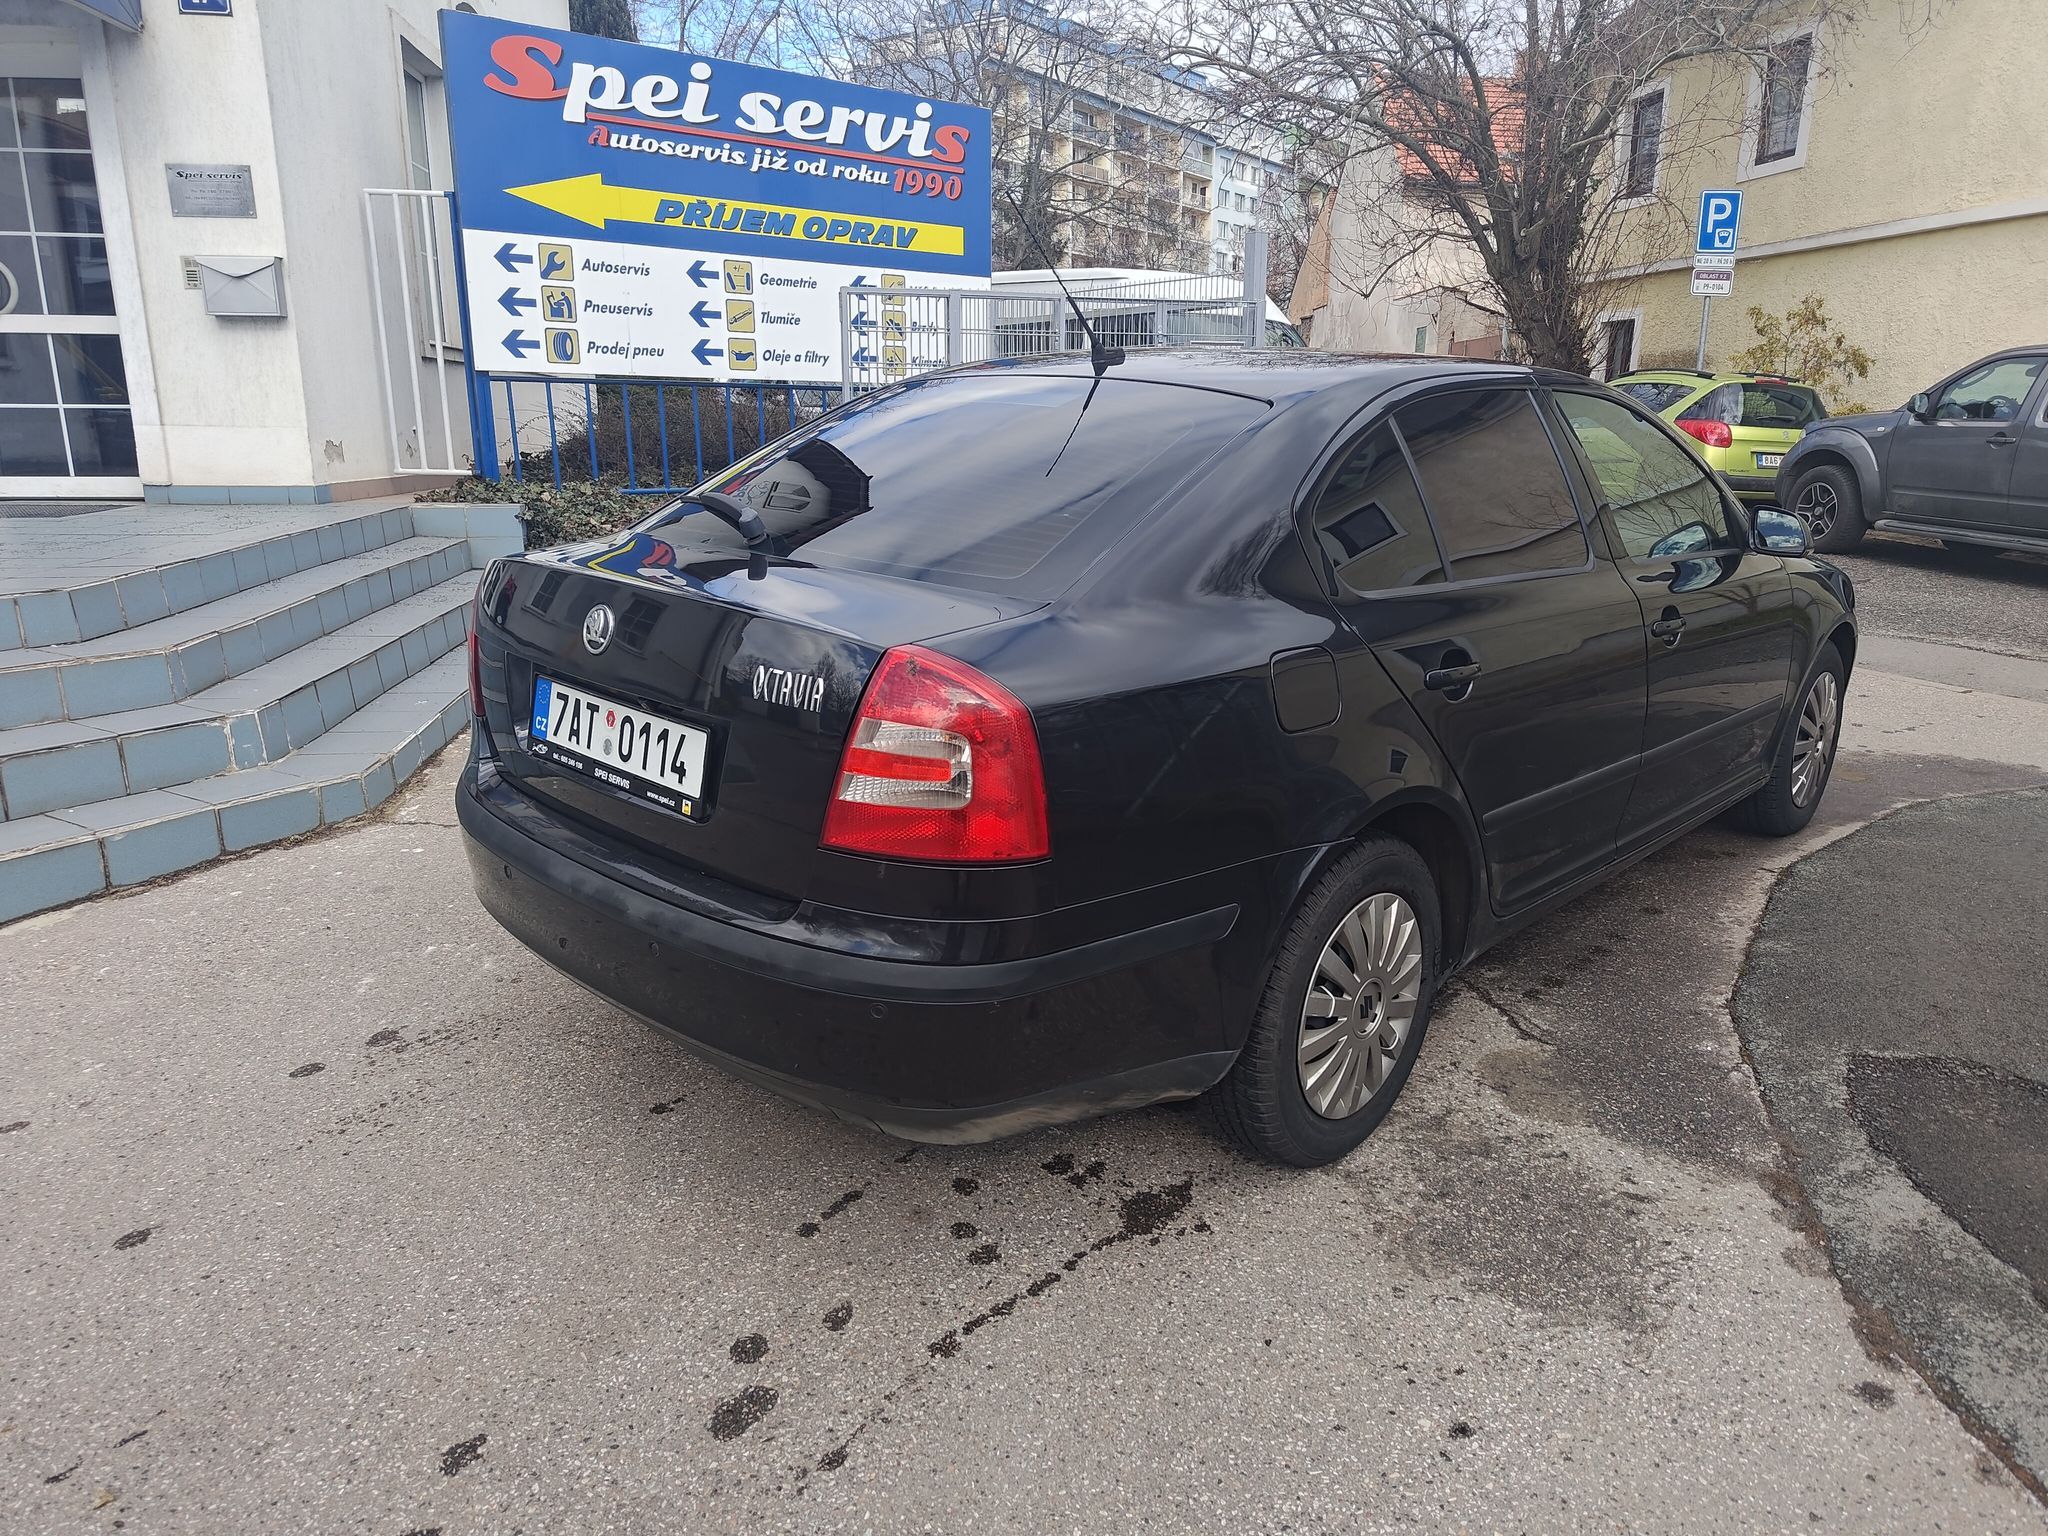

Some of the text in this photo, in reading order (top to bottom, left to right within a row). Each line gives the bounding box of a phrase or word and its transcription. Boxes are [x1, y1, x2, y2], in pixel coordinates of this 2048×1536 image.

[483, 34, 971, 164] Spei servis
[587, 124, 964, 201] Autoservis již od roku 1990
[175, 169, 243, 180] Spei servis
[654, 198, 919, 249] PŘÍJEM OPRAV
[1706, 198, 1733, 233] P
[581, 258, 651, 277] Autoservis
[760, 273, 818, 290] Geometrie
[583, 299, 654, 317] Pneuservis
[761, 311, 801, 326] Tlumiče
[586, 341, 665, 359] Prodej pneu
[762, 349, 830, 368] Oleje a filtry
[753, 665, 824, 713] OCTAVIA
[535, 715, 547, 731] CZ
[552, 691, 687, 785] 7AT 0114
[594, 767, 631, 790] SPEI SERVIS
[646, 790, 676, 808] www.spei.cz
